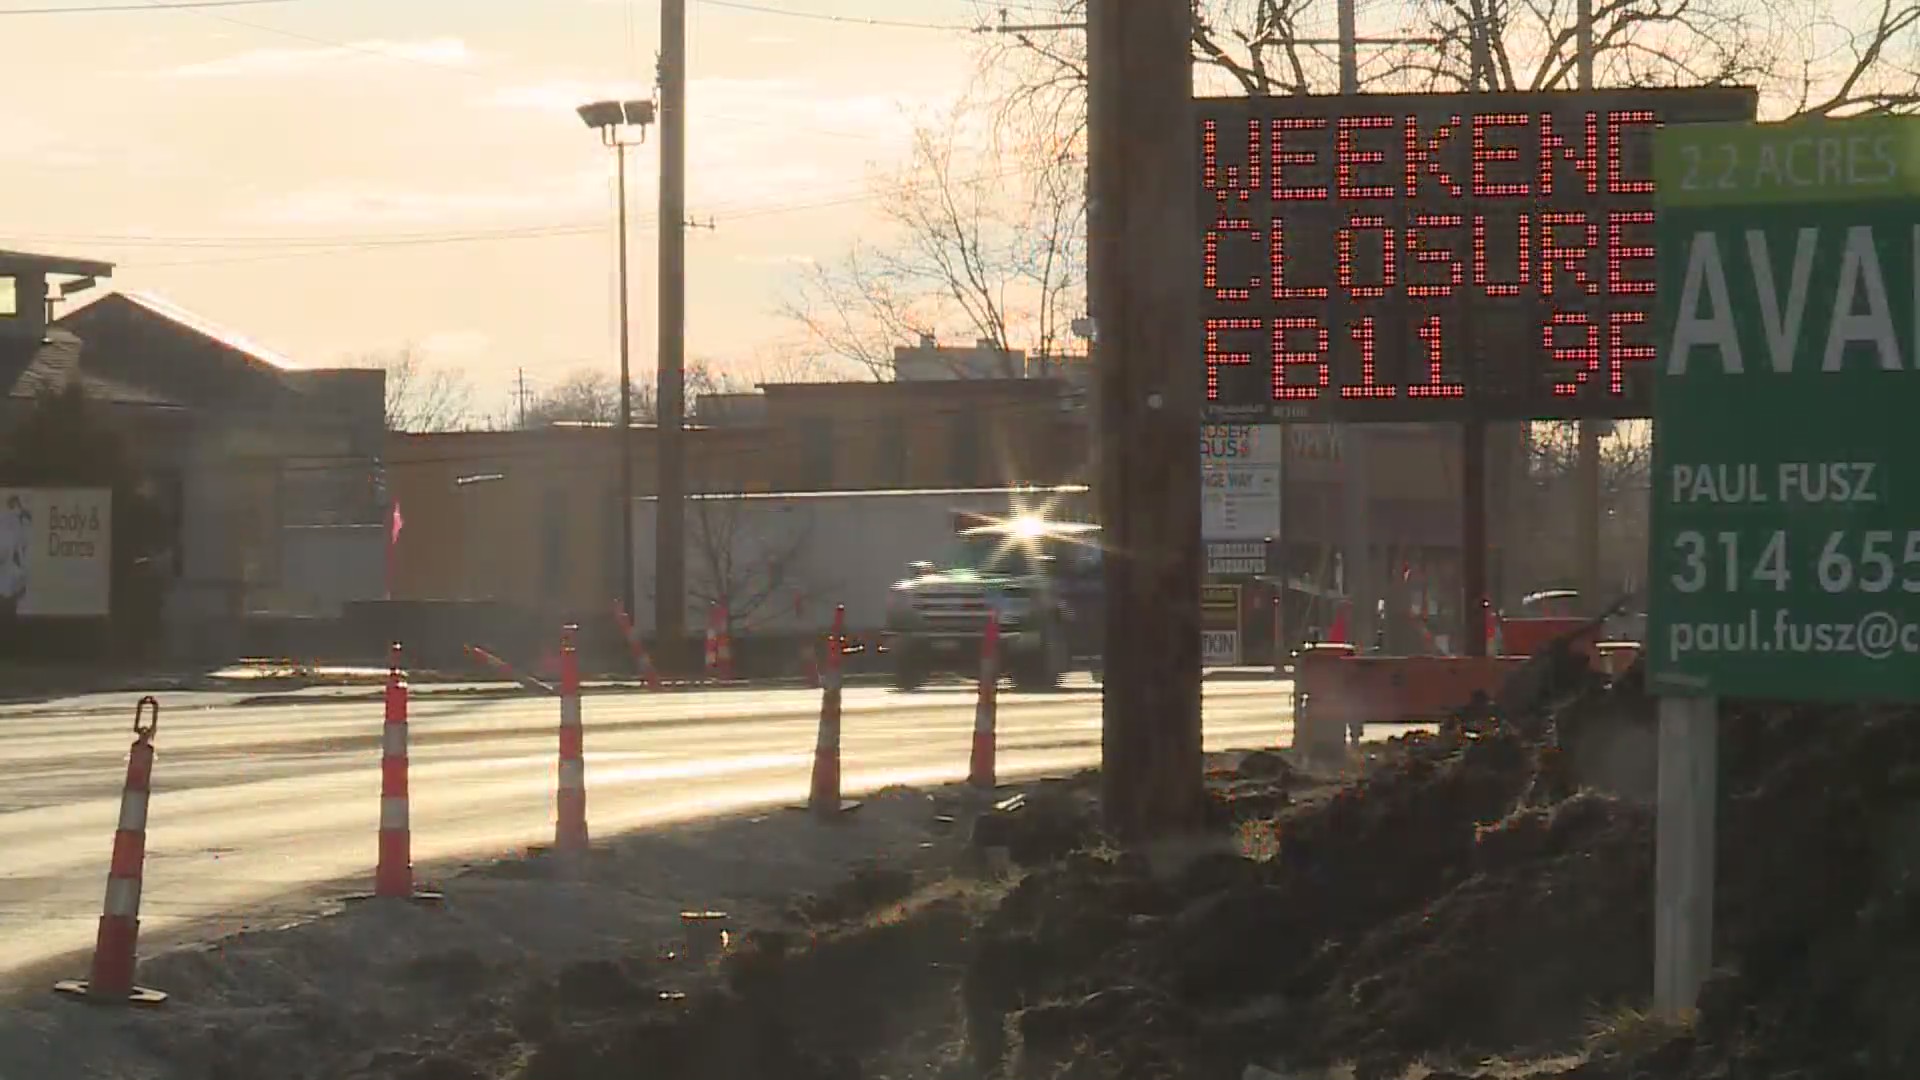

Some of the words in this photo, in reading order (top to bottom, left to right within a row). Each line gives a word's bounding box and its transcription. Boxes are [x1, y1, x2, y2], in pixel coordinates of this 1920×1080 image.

[1680, 143, 1738, 190] 2.2
[1752, 134, 1898, 188] ACRES
[1203, 211, 1657, 301] CLOSURE
[1204, 315, 1465, 400] FB11
[1673, 463, 1767, 502] PAUL
[1779, 462, 1877, 502] FUSZ
[49, 504, 87, 538] Body
[1670, 530, 1791, 593] 314
[1817, 530, 1920, 593] 655
[1670, 608, 1920, 661] paul.fusz@c
